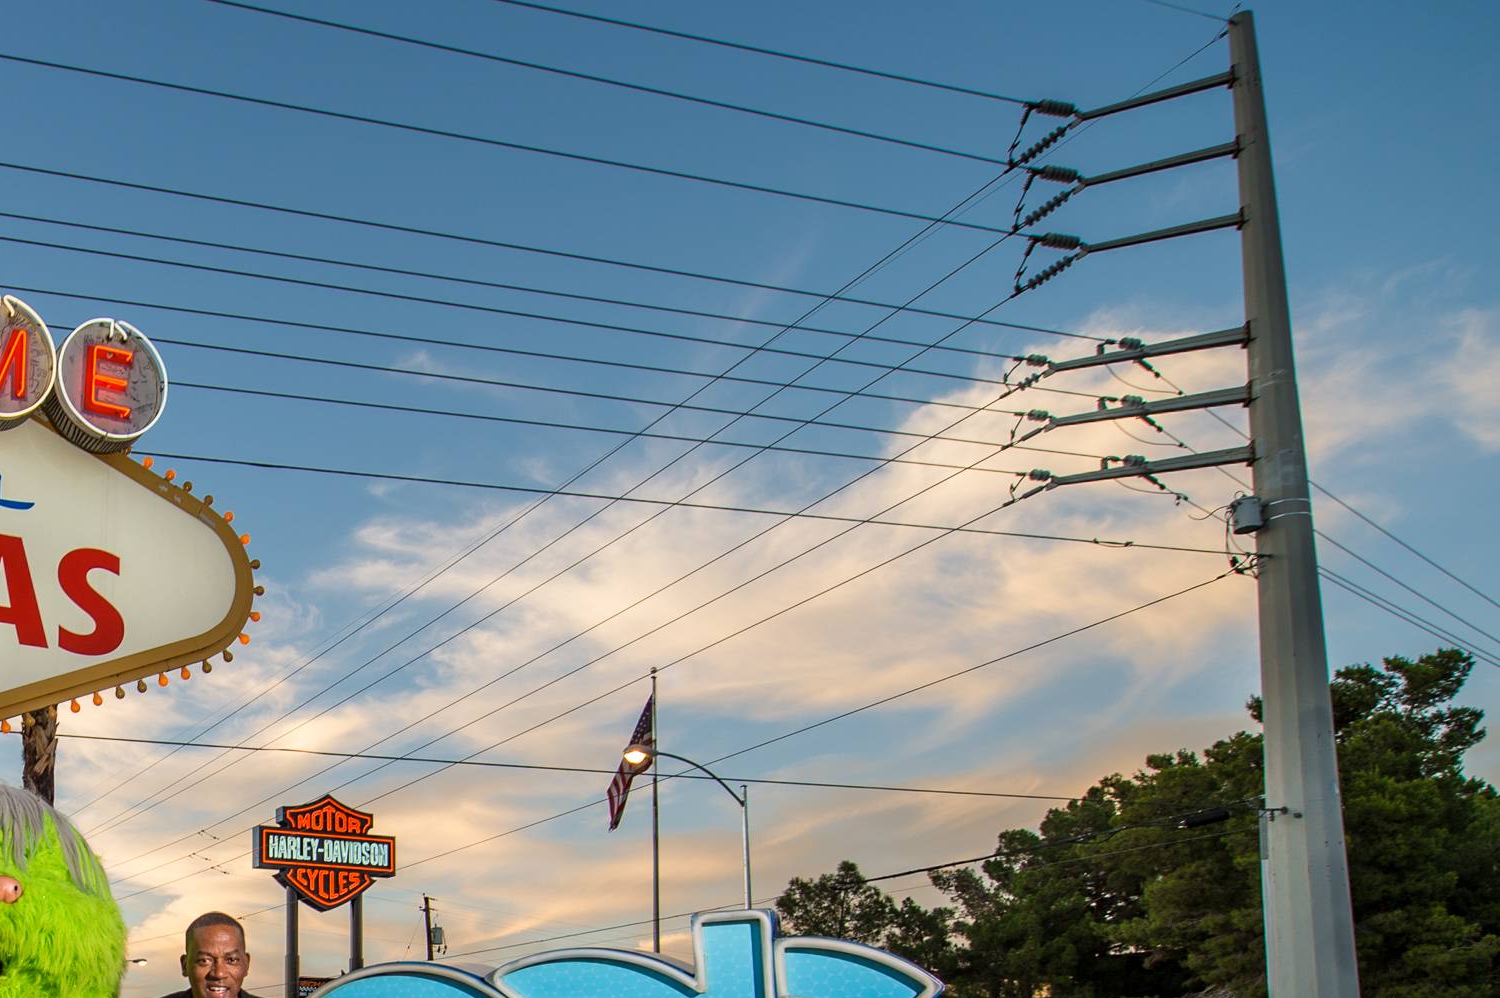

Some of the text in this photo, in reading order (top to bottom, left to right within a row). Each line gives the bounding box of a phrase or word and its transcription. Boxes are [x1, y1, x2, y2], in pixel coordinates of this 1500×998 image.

[297, 805, 361, 834] MOTOR
[268, 834, 389, 867] HARLEY-DAVIDSON
[296, 868, 361, 900] CYCLES
